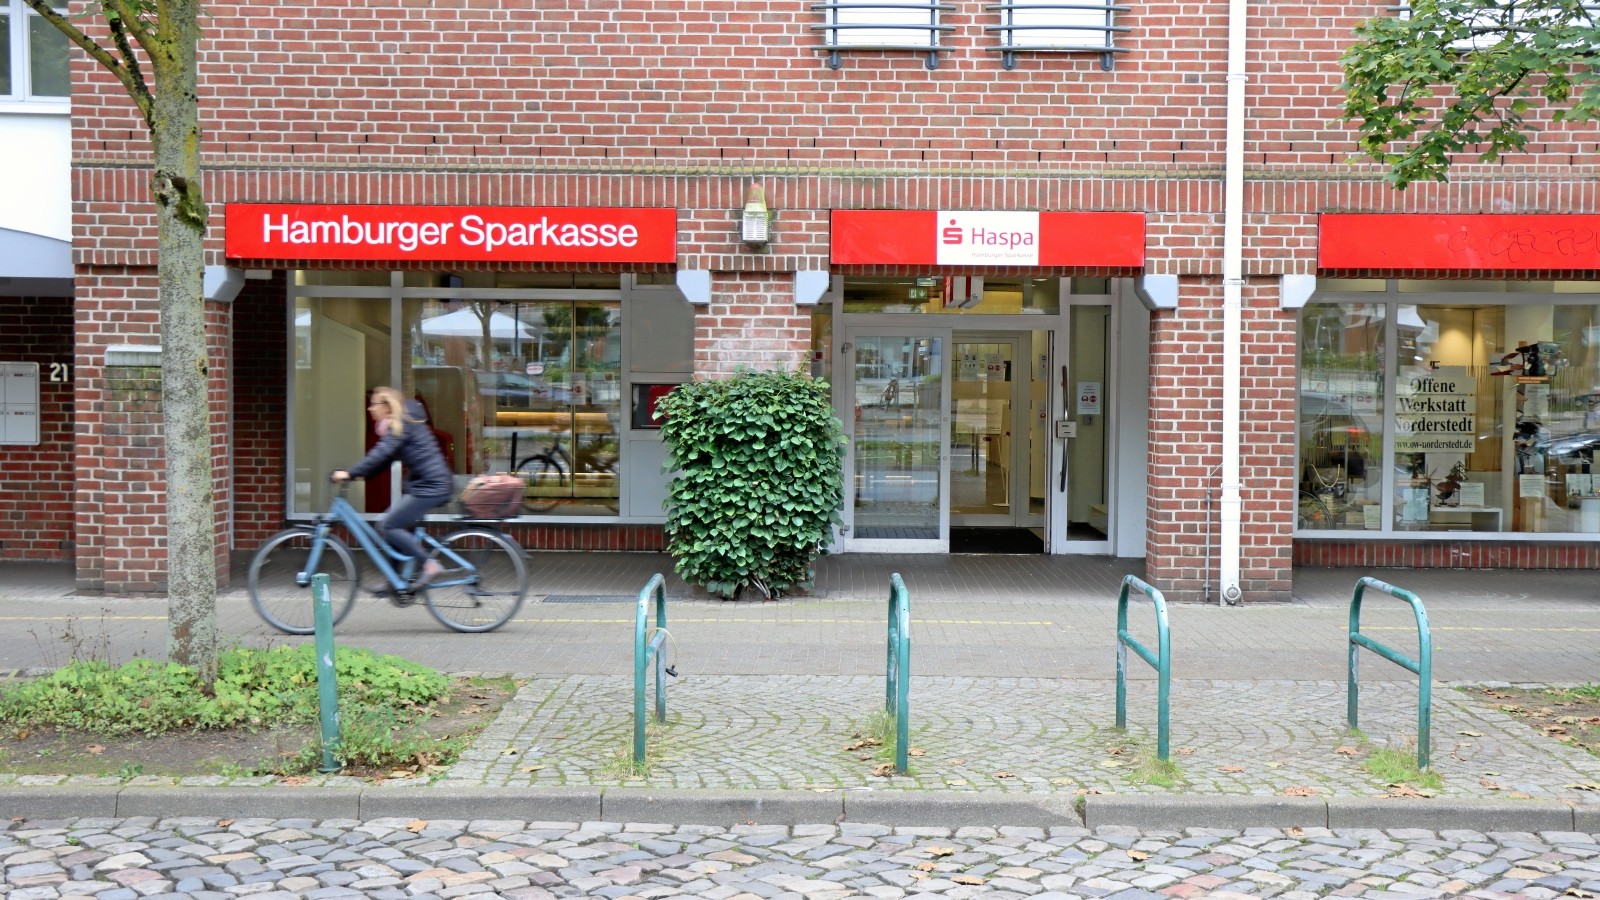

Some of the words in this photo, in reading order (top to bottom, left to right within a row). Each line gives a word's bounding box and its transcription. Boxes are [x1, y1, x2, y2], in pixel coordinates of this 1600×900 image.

[263, 213, 454, 251] Hamburger
[460, 214, 638, 252] Sparkasse
[971, 227, 1034, 250] Haspa
[50, 362, 69, 382] 21
[1410, 377, 1456, 393] Offene
[1399, 397, 1466, 413] Werkstatt
[1395, 416, 1473, 432] Norderstedt
[1395, 439, 1473, 449] ww.ow-norderstedt.de
